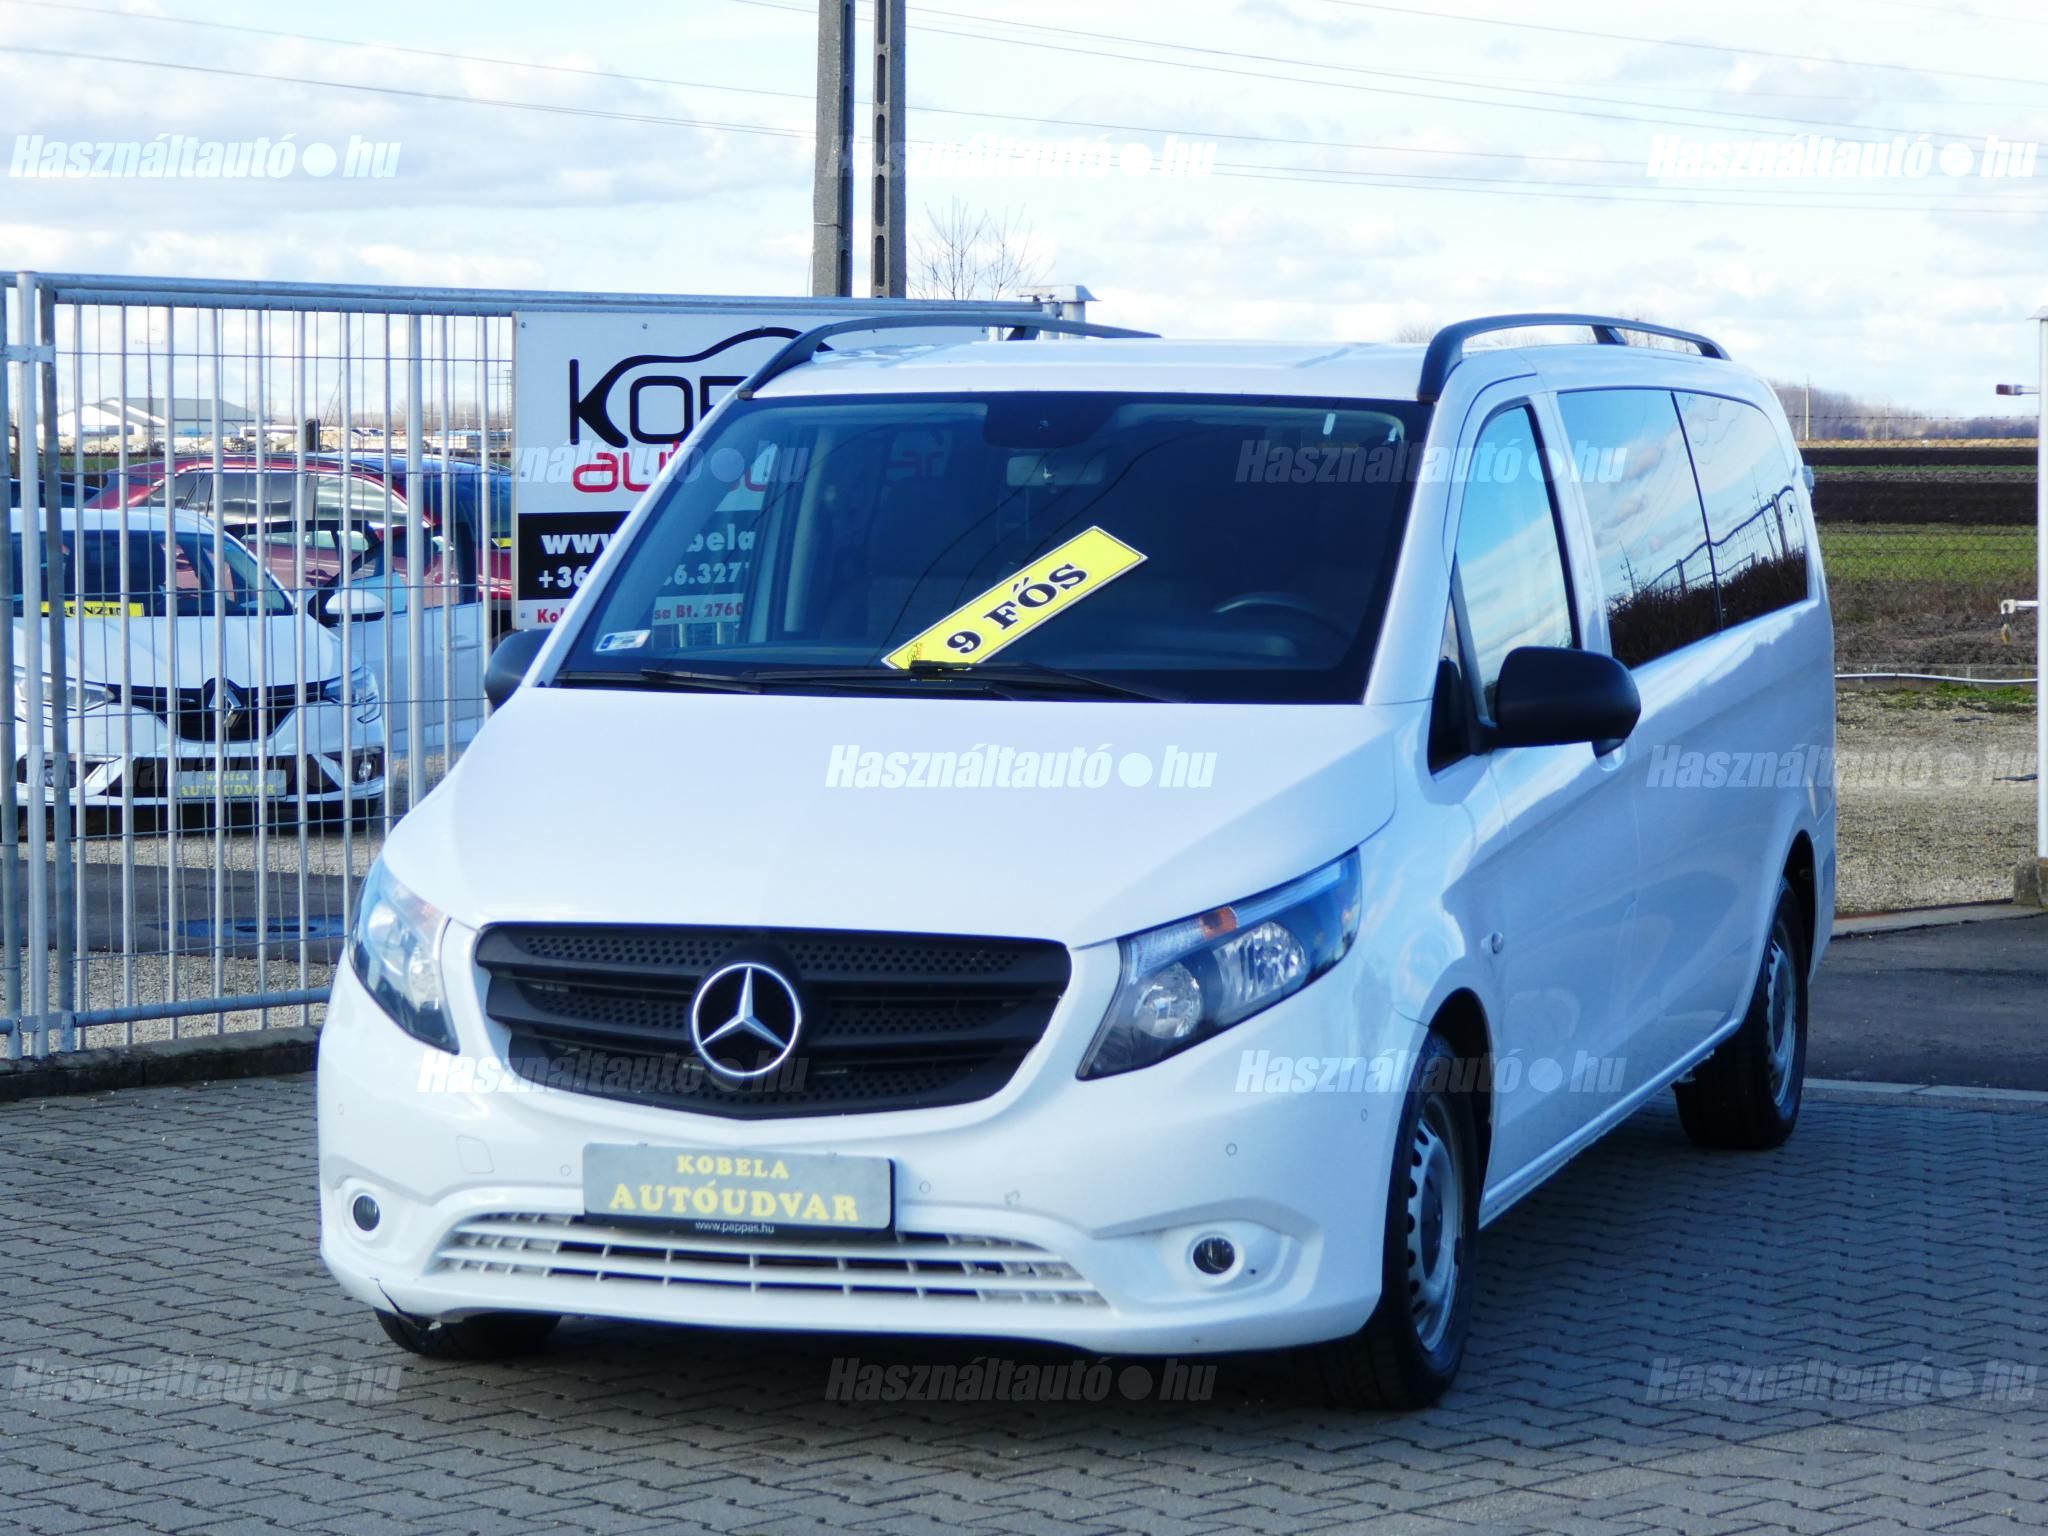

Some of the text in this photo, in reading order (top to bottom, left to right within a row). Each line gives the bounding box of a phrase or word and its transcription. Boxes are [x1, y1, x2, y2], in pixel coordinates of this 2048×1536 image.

[676, 603, 699, 619] Bt.
[946, 631, 982, 653] 9
[983, 563, 1088, 630] FŐS
[676, 1154, 790, 1180] KOBELA
[608, 1179, 860, 1223] AUTÓUDVAR
[695, 1220, 776, 1235] www.pappas.hu
